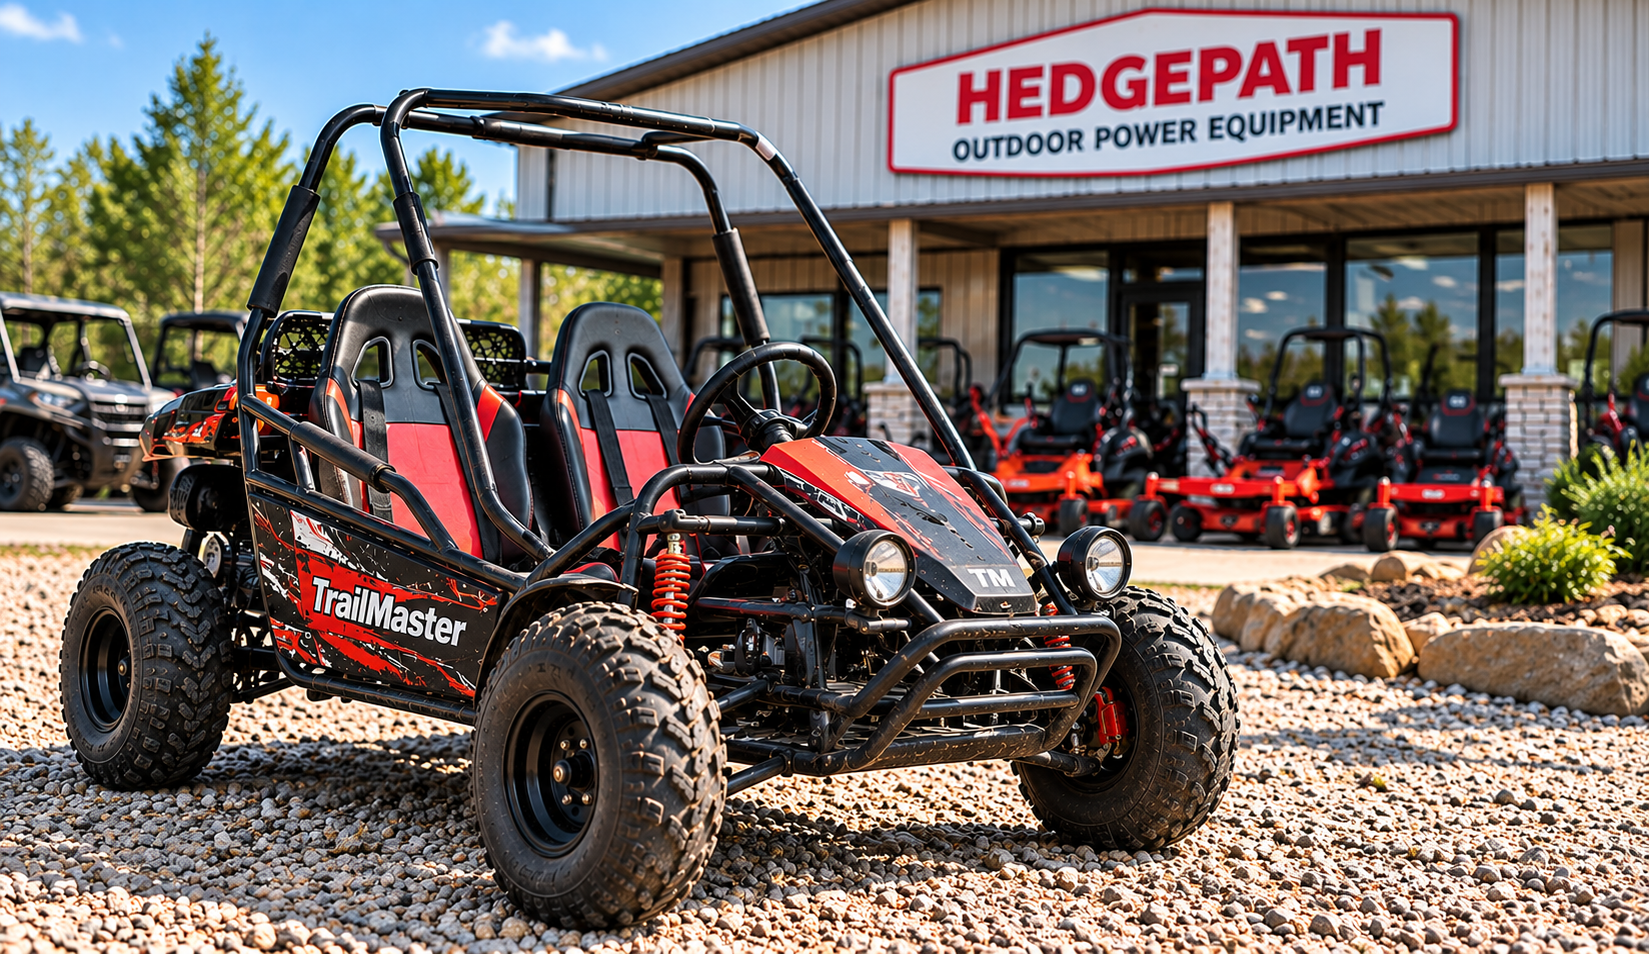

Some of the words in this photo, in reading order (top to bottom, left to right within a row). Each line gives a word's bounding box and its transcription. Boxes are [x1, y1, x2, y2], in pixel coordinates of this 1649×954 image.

[956, 28, 1382, 124] HEDGEPATH
[953, 131, 1083, 162] OUTDOOR
[1095, 119, 1197, 150] POWER
[1209, 101, 1386, 142] EQUIPMENT
[968, 568, 1015, 588] TM
[312, 577, 467, 646] TrailMaster
